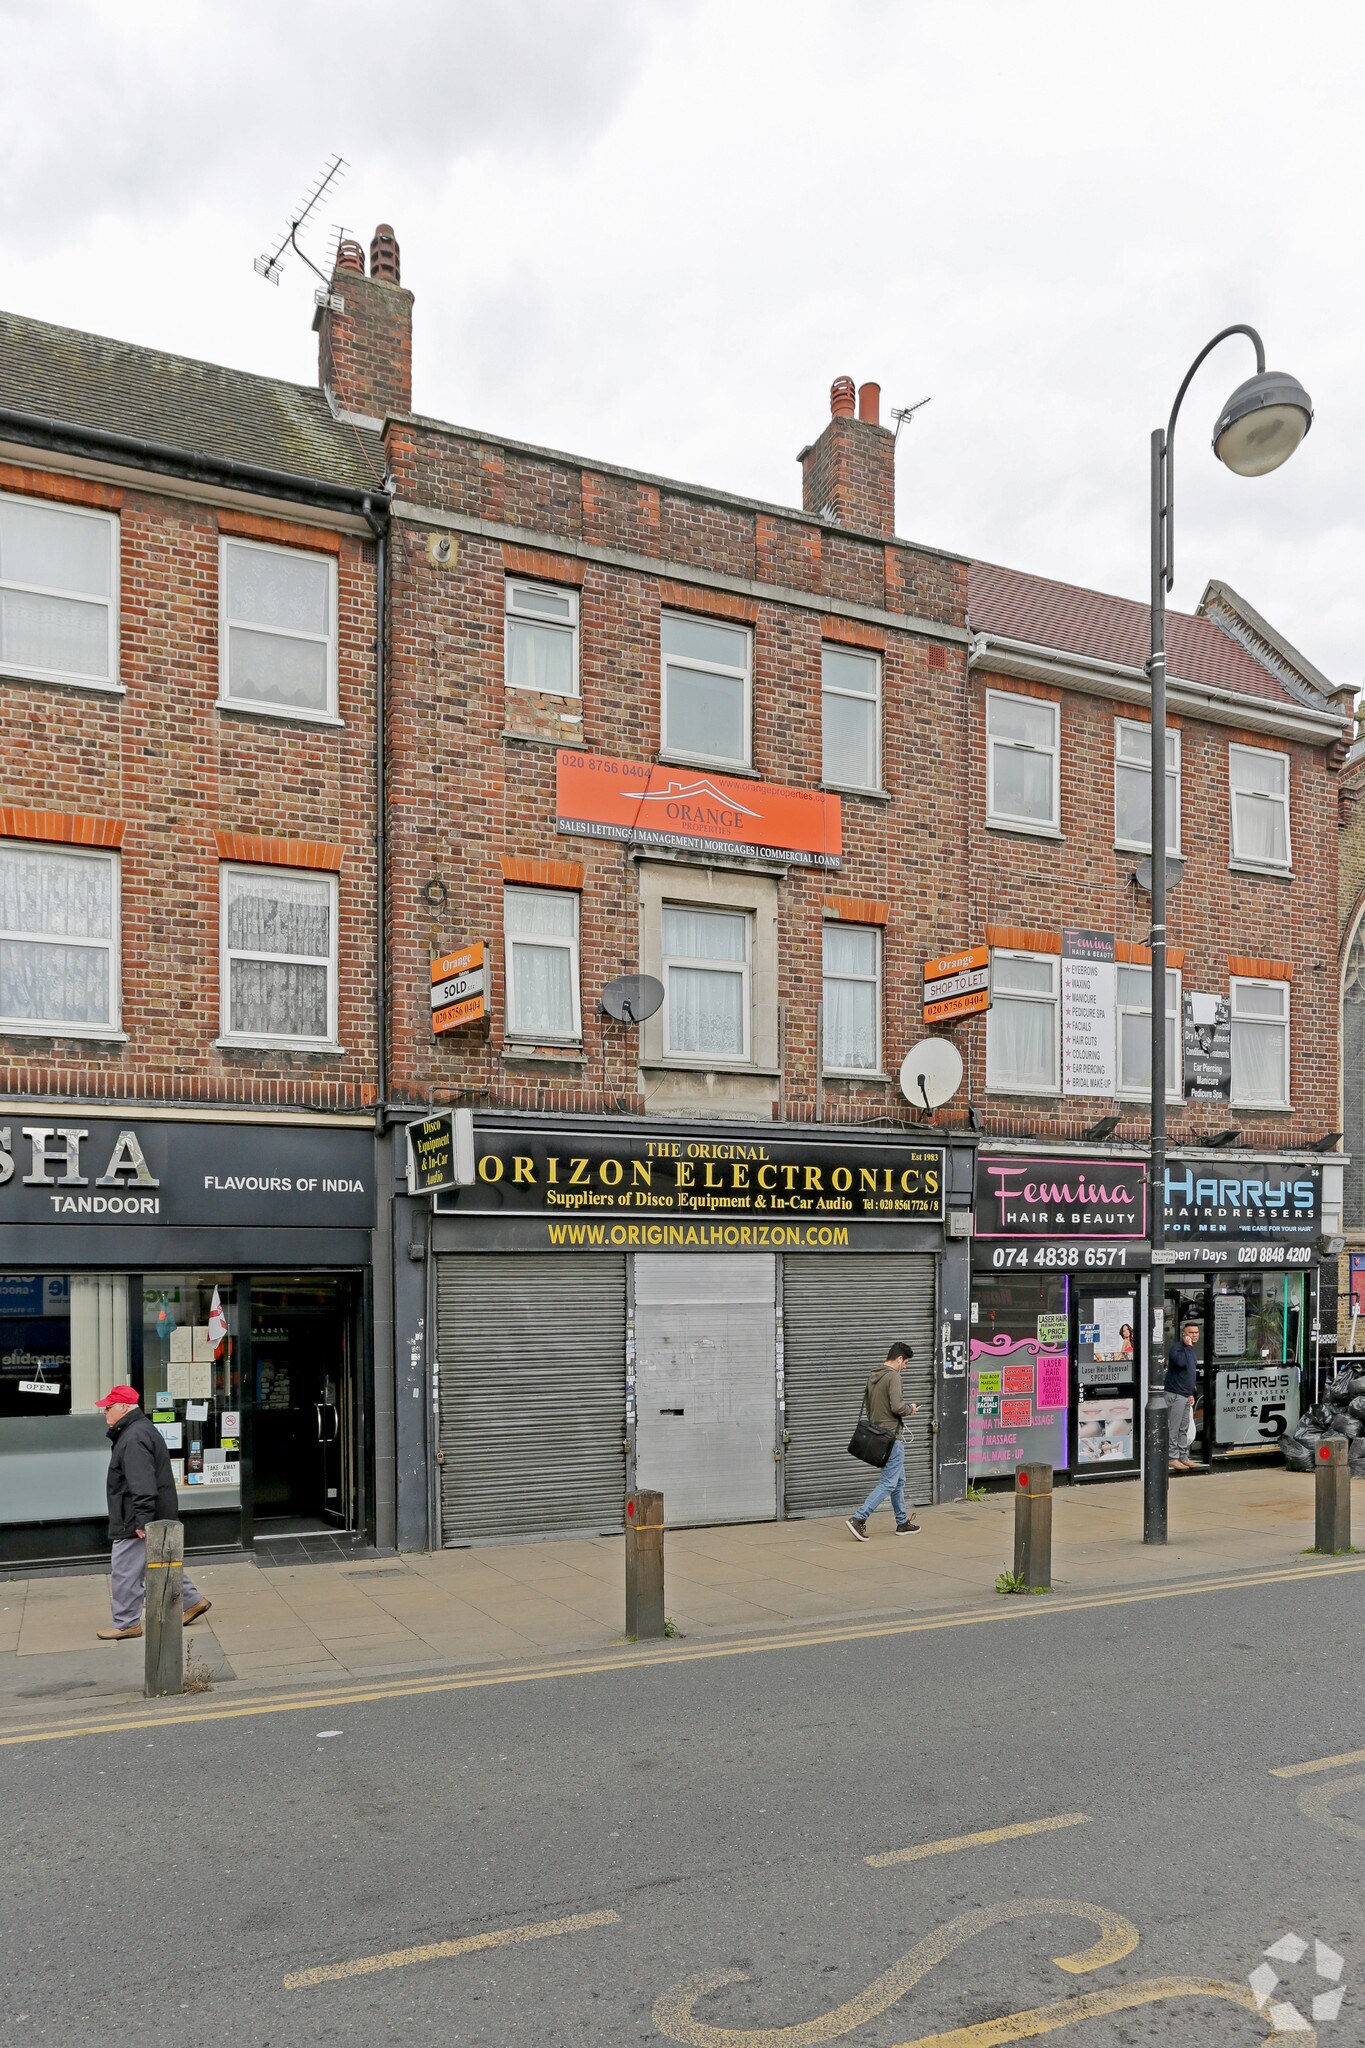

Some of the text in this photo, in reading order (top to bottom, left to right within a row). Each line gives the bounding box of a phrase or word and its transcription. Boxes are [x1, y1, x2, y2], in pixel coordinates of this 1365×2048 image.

[562, 754, 651, 778] 020 8756 0404
[666, 802, 744, 829] ORANGE
[682, 822, 731, 836] PROPERTIES
[560, 820, 840, 867] SALES LETTINGS MANAGEMENT MORTGAGES COMMERCIAL LOANS
[1064, 930, 1113, 955] Femina
[1092, 951, 1114, 959] BEAUTY
[442, 954, 472, 972] Orange
[938, 955, 974, 971] Orange
[1071, 965, 1098, 976] EYEBROWS
[444, 981, 467, 999] SOLD
[930, 973, 984, 996] SHOP TO LET
[1072, 979, 1090, 990] WAXING
[927, 1004, 942, 1016] 020
[943, 1000, 963, 1012] 8756
[964, 994, 984, 1008] 0404
[1072, 993, 1097, 1004] MANICURE
[435, 1012, 446, 1024] 020
[448, 1006, 462, 1020] 8756
[464, 1001, 480, 1014] 0404
[1072, 1007, 1105, 1019] PEDICURE SPA
[1072, 1021, 1091, 1031] FACIALS
[1072, 1035, 1097, 1046] HAIR CUTS
[1072, 1049, 1100, 1060] COLOURING
[1072, 1063, 1105, 1075] EAR PIERCING
[1193, 1062, 1222, 1075] Ear Piercing
[1072, 1077, 1089, 1088] BRIDAL
[1197, 1075, 1219, 1086] Manicure
[1191, 1088, 1222, 1101] Pedicure Spa
[423, 1120, 441, 1135] Disco
[417, 1133, 450, 1155] Equipment
[646, 1142, 770, 1161] THE ORIGINAL
[911, 1152, 939, 1161] Est 1983
[421, 1153, 448, 1171] & In-Car
[426, 1170, 443, 1186] Audio
[478, 1155, 939, 1194] ORIZON ELECTRONICS
[1311, 1169, 1319, 1177] 56
[204, 1175, 364, 1193] FLAVOURS OF INDIA
[1164, 1167, 1314, 1208] HARRY'S
[547, 1189, 614, 1209] Suppliers
[618, 1191, 633, 1206] of
[635, 1191, 673, 1207] Disco
[677, 1192, 751, 1211] Equipment
[754, 1194, 767, 1209] &
[771, 1194, 814, 1209] In-Car
[816, 1196, 853, 1210] Audio
[880, 1199, 893, 1210] 020
[987, 1166, 1135, 1226] Femina
[50, 1196, 160, 1214] TANDOORI
[1007, 1212, 1135, 1224] HAIR & BEAUTY
[1164, 1208, 1314, 1218] HAIRDRESSERS
[548, 1224, 849, 1246] WWW.ORIGINALHORIZON.COM
[1199, 1224, 1227, 1232] MEN
[993, 1247, 1126, 1267] 074 4838 6571
[1193, 1248, 1228, 1264] 7 Days
[1238, 1247, 1312, 1263] 020 8848 4200
[1039, 1315, 1055, 1323] LASER
[1043, 1359, 1062, 1368] LASER
[1045, 1368, 1060, 1376] HAIR
[1091, 1373, 1120, 1382] SPECIALIST
[26, 1383, 52, 1391] OPEN
[1226, 1373, 1289, 1390] HARRY'S
[1226, 1389, 1289, 1397] HAIRDRESSERS
[1031, 1415, 1055, 1426] ASSAGE
[985, 1434, 1017, 1445] MASSAGE
